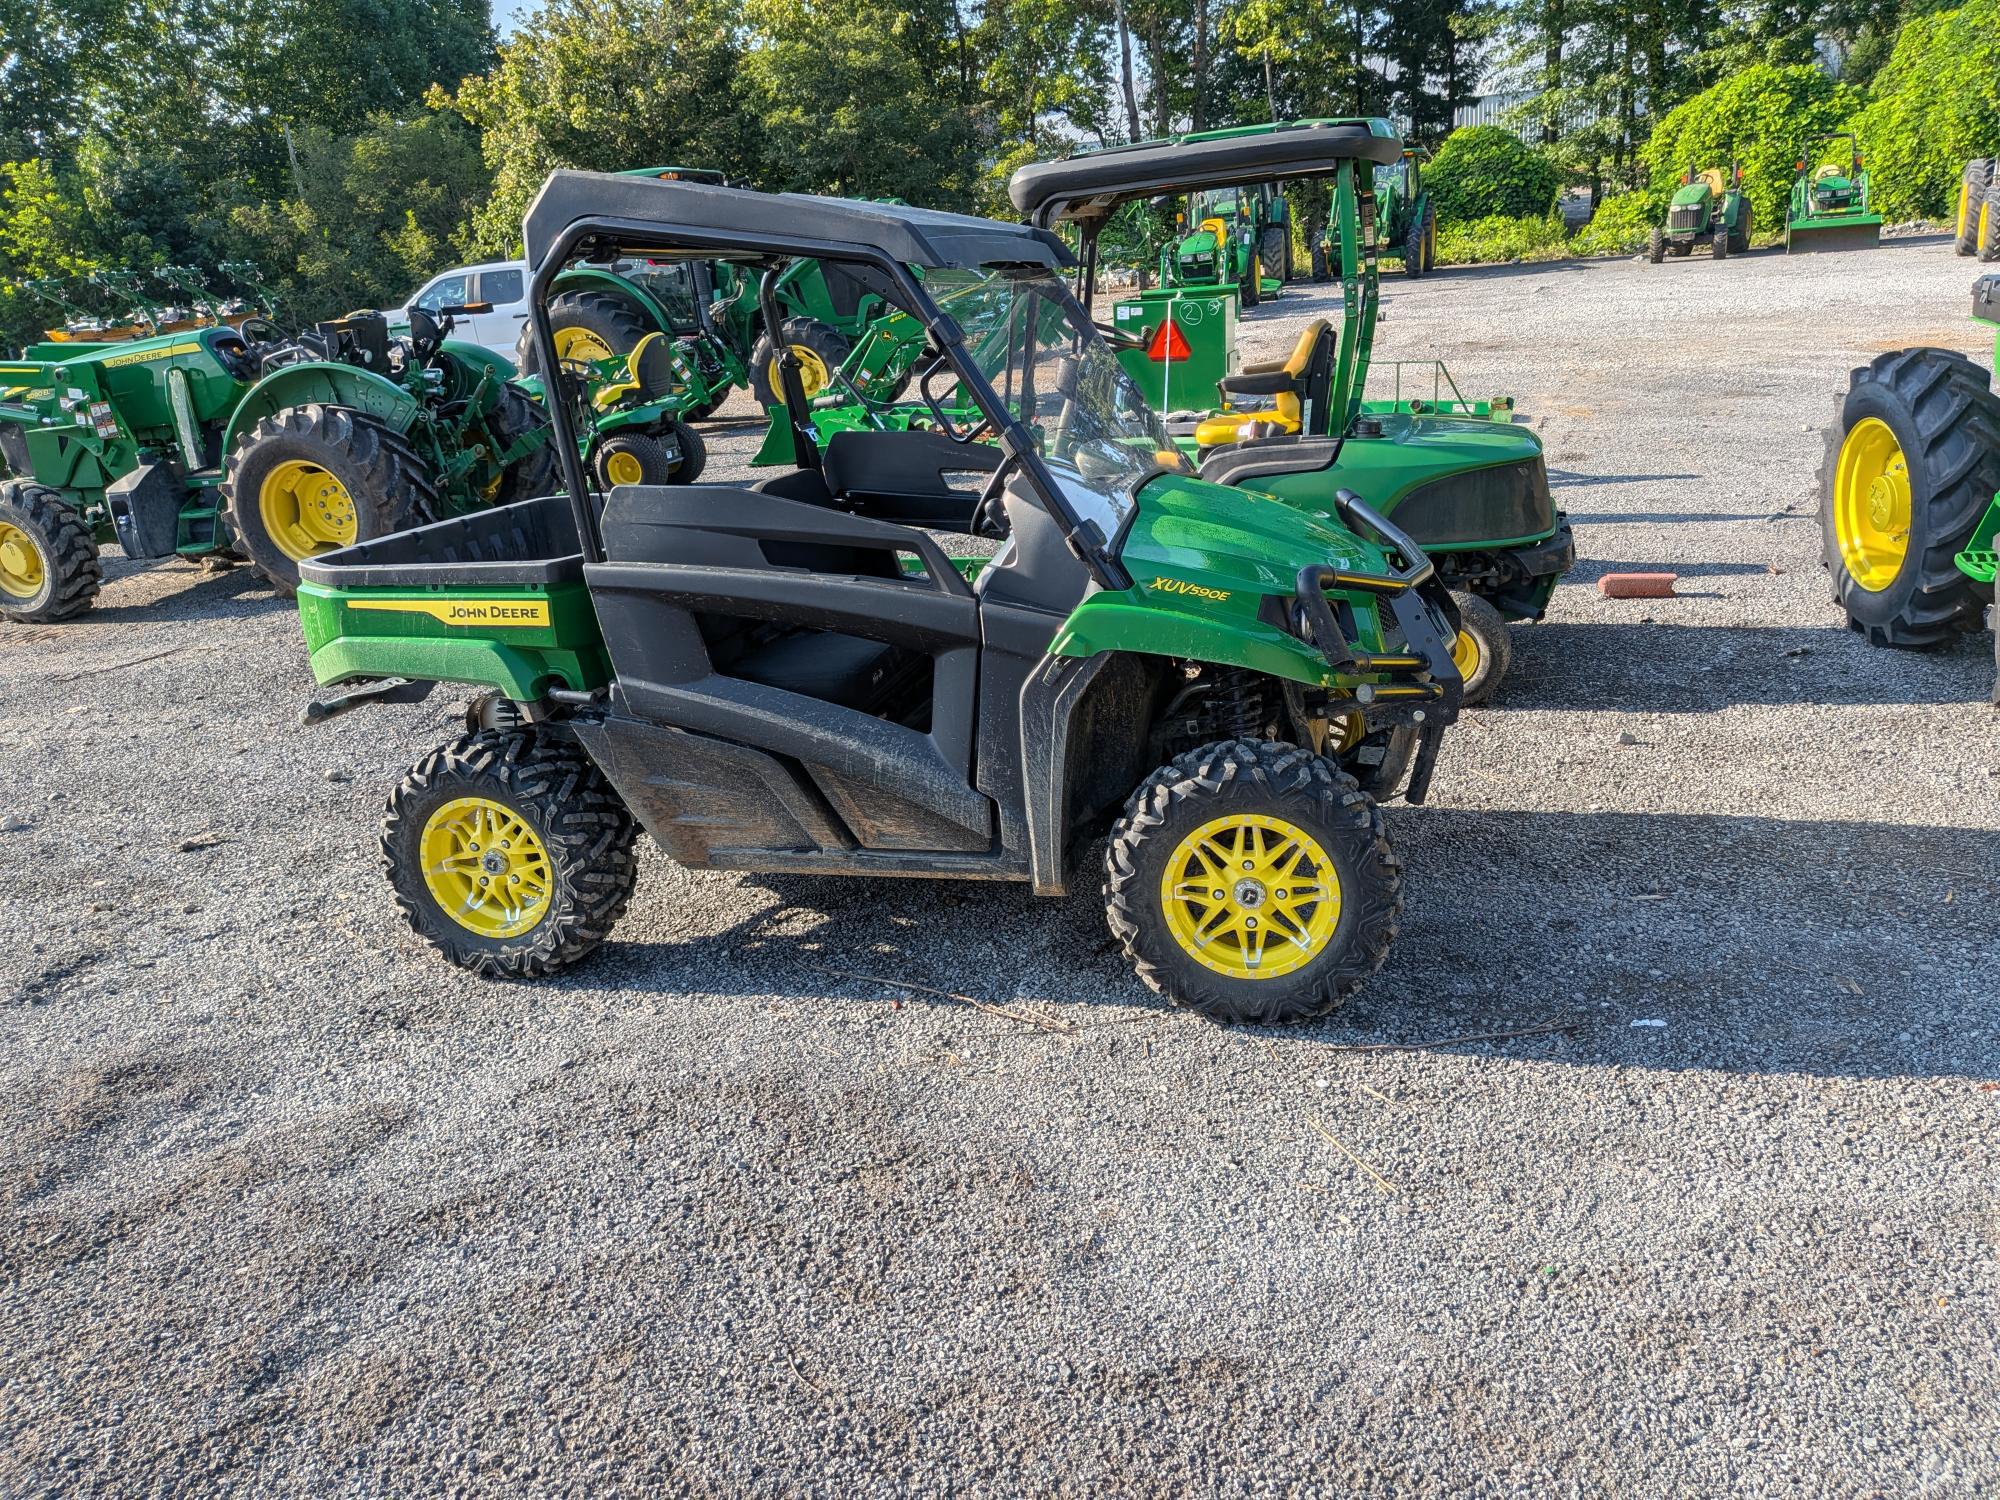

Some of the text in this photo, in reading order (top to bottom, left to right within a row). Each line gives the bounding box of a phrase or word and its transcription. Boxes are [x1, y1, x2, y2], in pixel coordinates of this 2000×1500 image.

[112, 351, 163, 367] JOHN DEERE
[1148, 576, 1232, 601] XUV590E
[449, 605, 540, 618] JOHN DEERE
